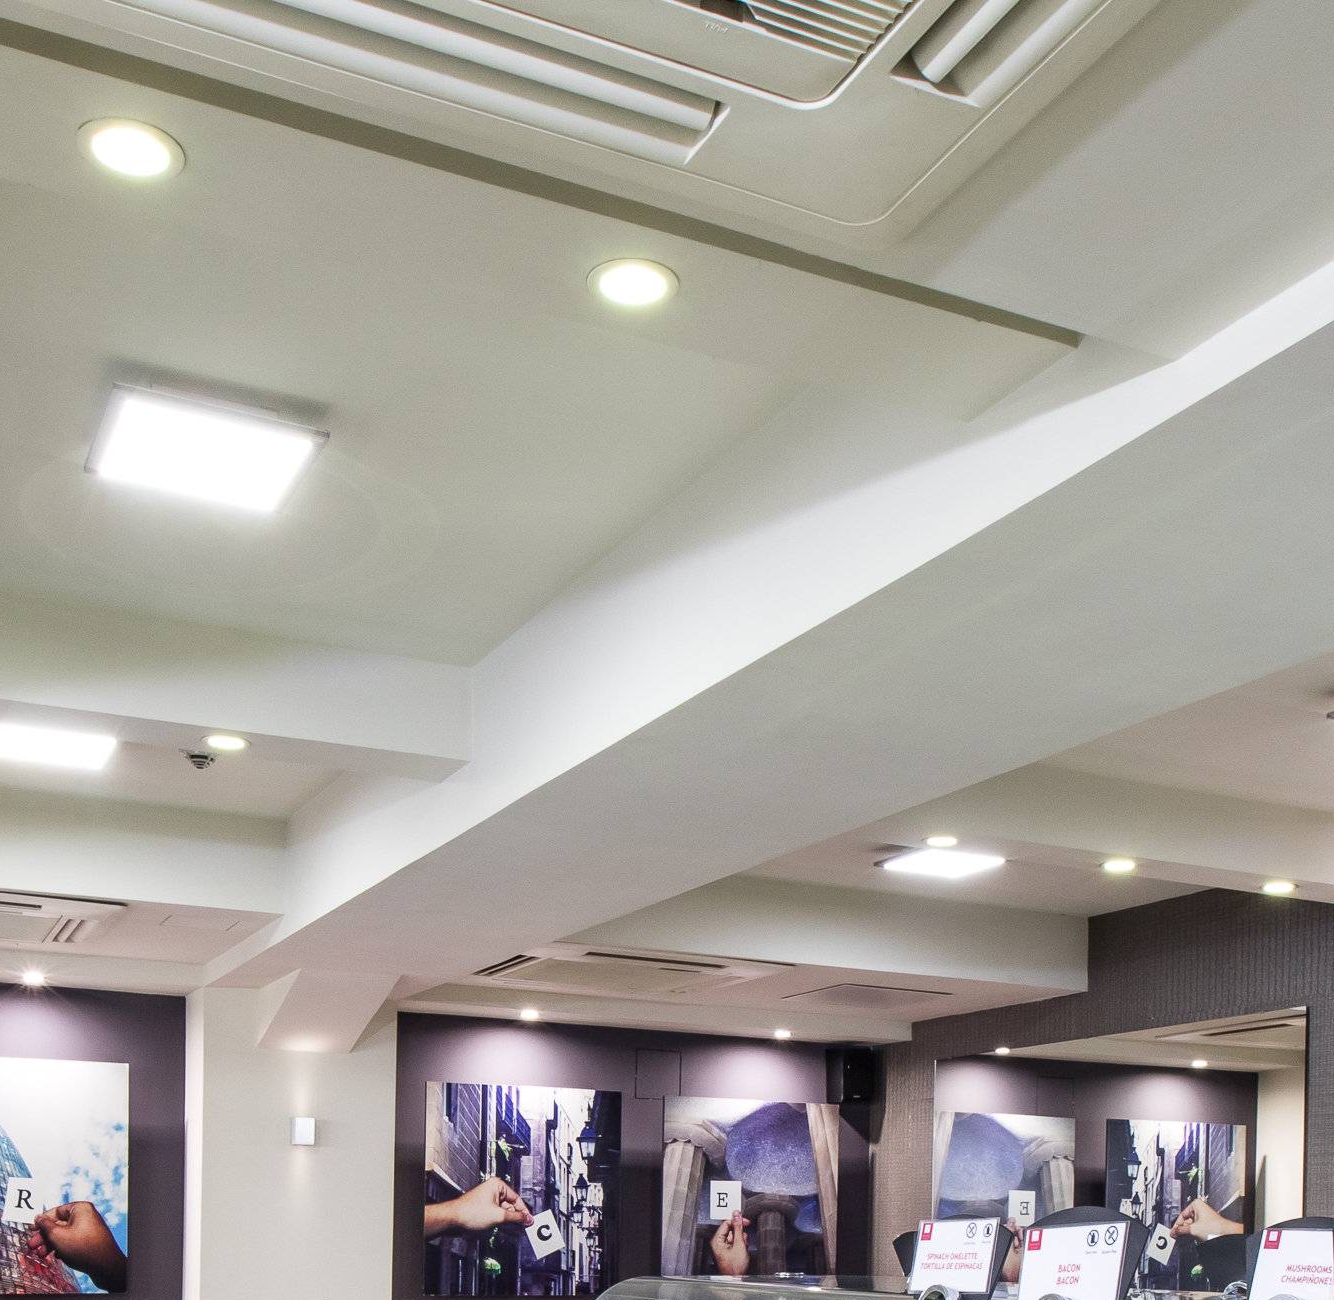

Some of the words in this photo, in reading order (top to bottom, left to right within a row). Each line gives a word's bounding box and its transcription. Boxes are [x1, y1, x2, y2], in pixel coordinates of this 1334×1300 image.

[14, 1188, 35, 1210] R
[716, 1192, 729, 1208] E
[536, 1224, 553, 1242] C
[927, 1252, 949, 1260] SPINACH
[950, 1252, 979, 1260] OMELETTE
[921, 1262, 945, 1270] TORTILLA
[946, 1262, 954, 1270] DE
[954, 1262, 983, 1270] ESPINACAS
[1058, 1263, 1081, 1273] BACON
[1285, 1264, 1333, 1274] MUSHROOMS
[1056, 1275, 1080, 1285] BACON
